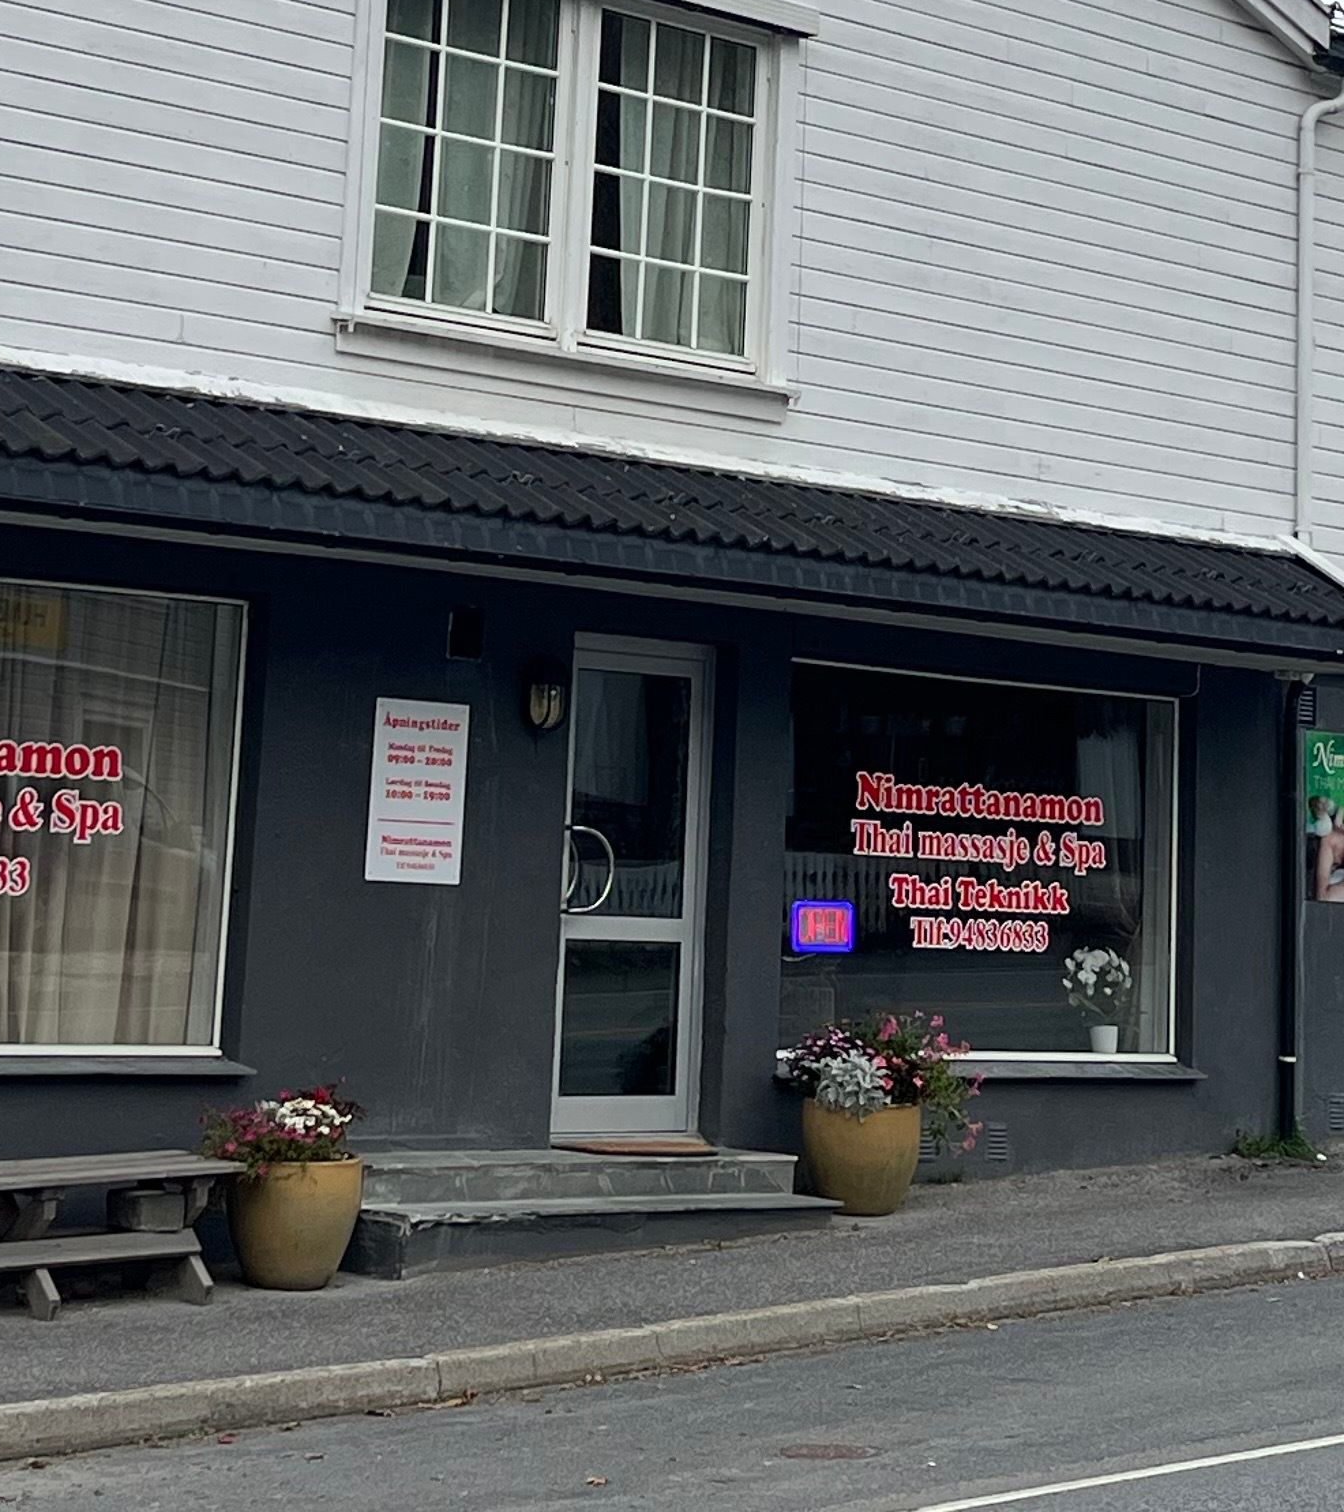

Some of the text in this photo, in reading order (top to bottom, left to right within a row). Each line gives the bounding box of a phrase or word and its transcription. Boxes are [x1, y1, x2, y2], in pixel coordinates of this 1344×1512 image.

[383, 711, 461, 732] Åpningstider
[8, 787, 44, 832] &
[50, 788, 123, 844] Spa
[855, 771, 1104, 825] Nimrattanamon
[850, 818, 1106, 876] Thai massasje & Spa
[889, 873, 1070, 914] Thai Teknikk
